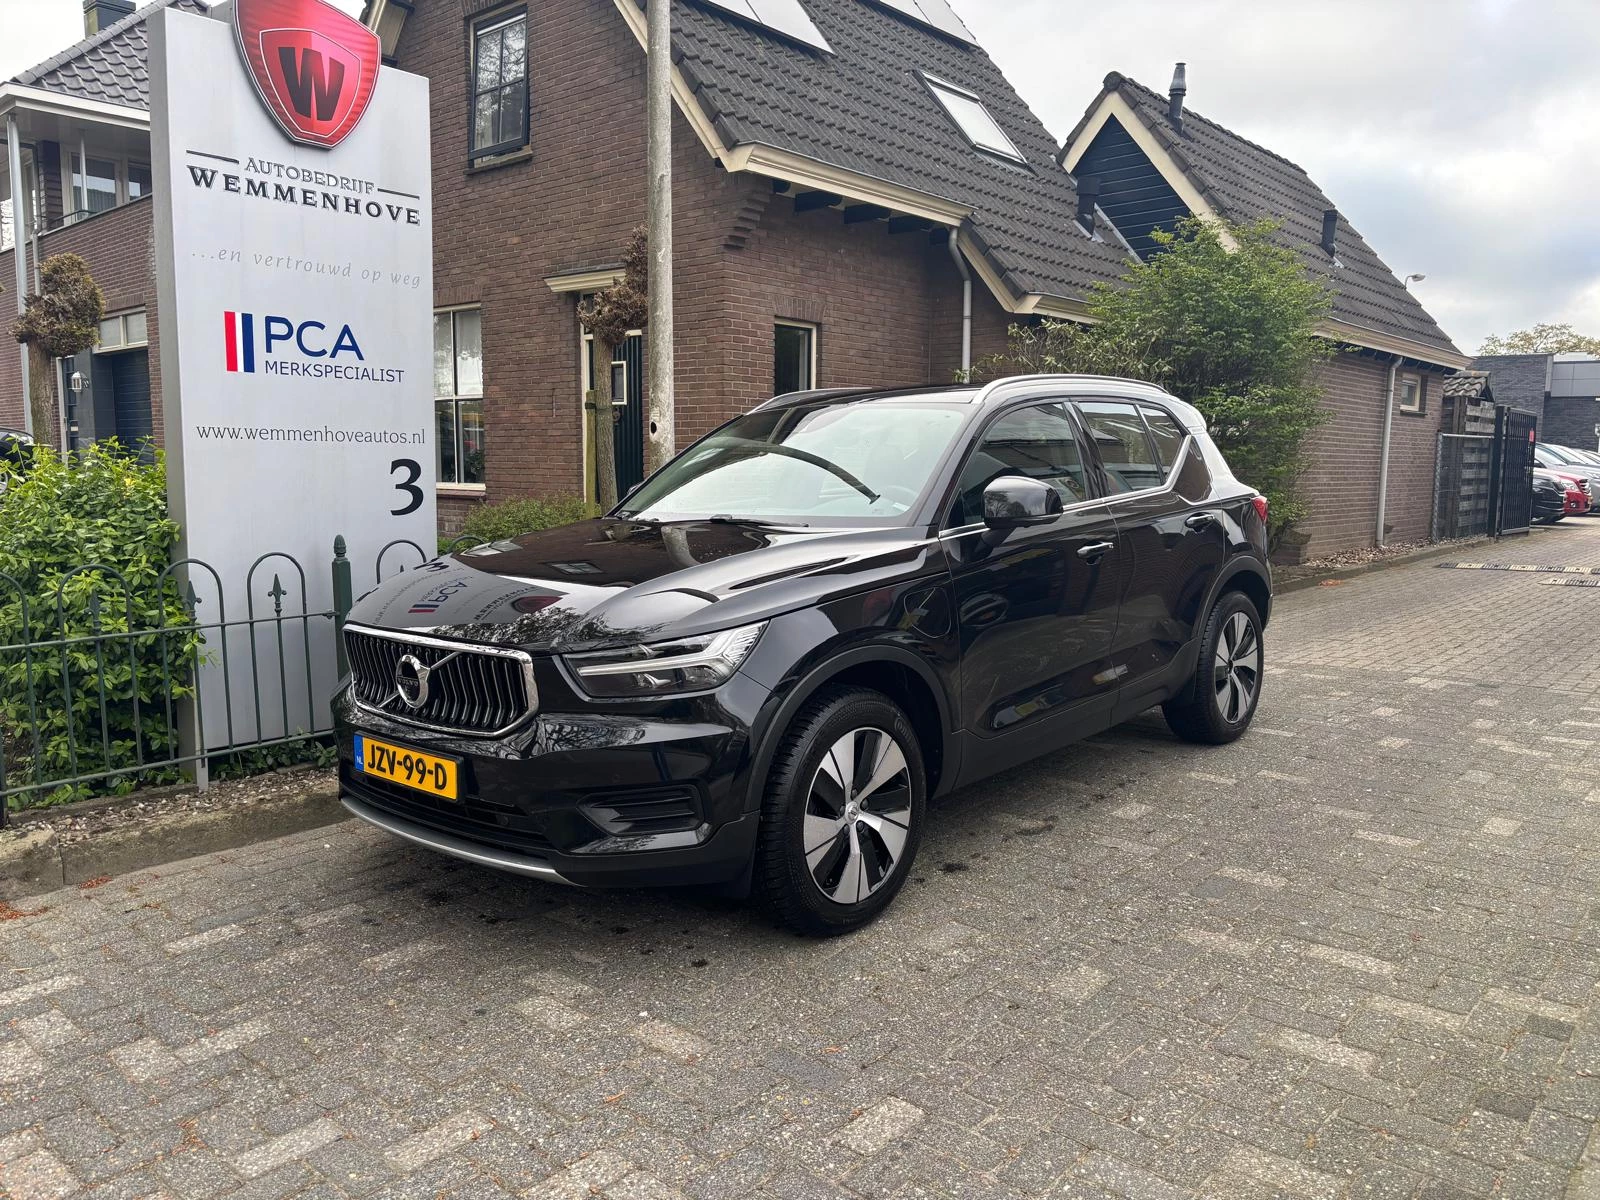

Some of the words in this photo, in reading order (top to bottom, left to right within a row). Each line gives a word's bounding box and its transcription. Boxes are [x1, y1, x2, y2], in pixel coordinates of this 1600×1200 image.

[278, 46, 345, 122] W
[186, 164, 421, 226] WEMMENHOVE
[244, 157, 375, 195] AUTOBEDRIJF
[253, 252, 352, 278] vertrouwd
[361, 267, 381, 282] op
[390, 272, 422, 289] weg
[264, 315, 365, 361] PCA
[265, 360, 405, 383] MERKSPECIALIST
[196, 425, 425, 445] www.wemmenhoveautos.nl
[390, 458, 424, 516] 3
[367, 744, 448, 791] JZV-99-D
